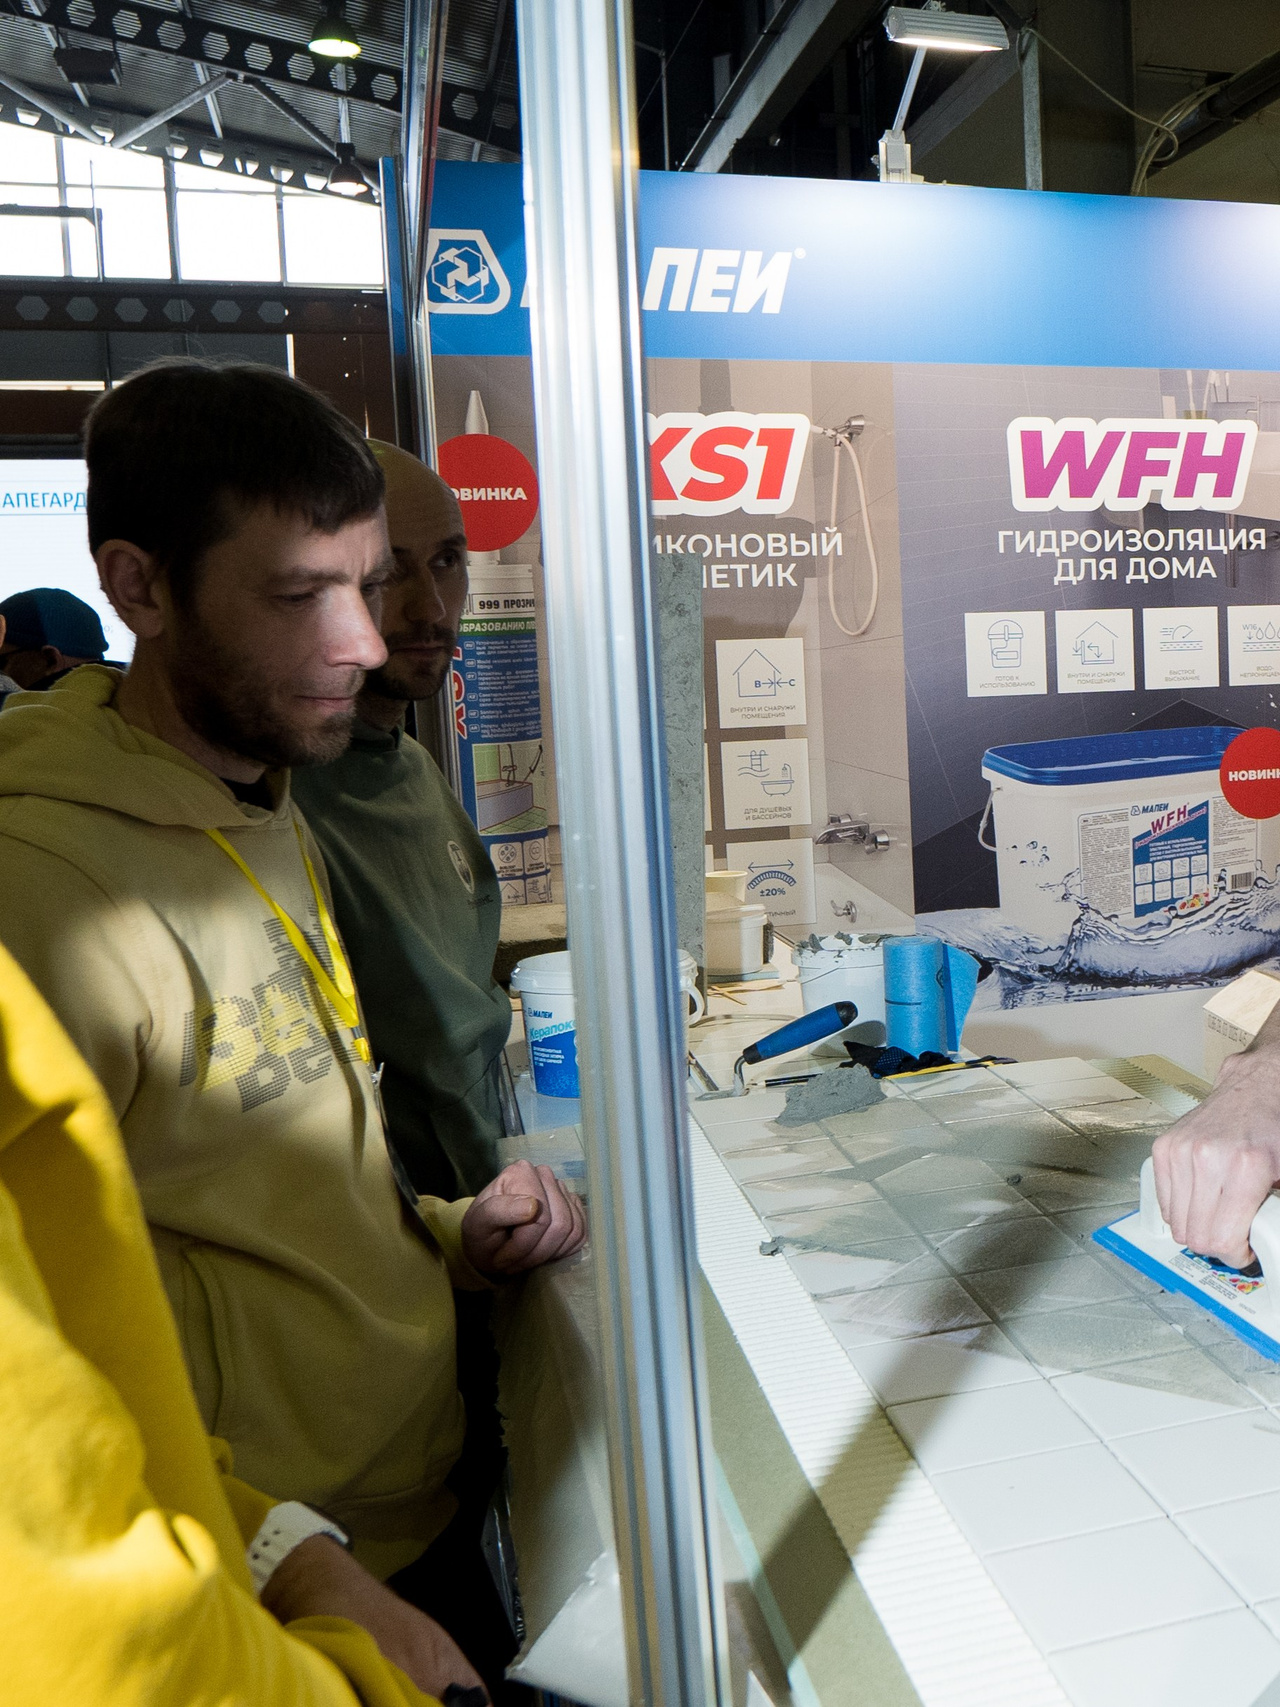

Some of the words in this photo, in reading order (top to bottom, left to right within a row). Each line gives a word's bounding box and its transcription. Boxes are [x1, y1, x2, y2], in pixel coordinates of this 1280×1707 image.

[641, 246, 793, 314] ПЕИ
[1020, 430, 1246, 499] WFH
[998, 528, 1267, 558] ГИДРОИЗОЛЯЦИЯ
[702, 563, 798, 589] ЕТИК
[1053, 558, 1118, 586] ДЛЯ
[1126, 556, 1218, 584] ДОМА
[478, 600, 500, 610] 999
[1141, 802, 1170, 814] МАПЕИ
[1150, 804, 1188, 834] WFH
[760, 887, 786, 897] ±20%
